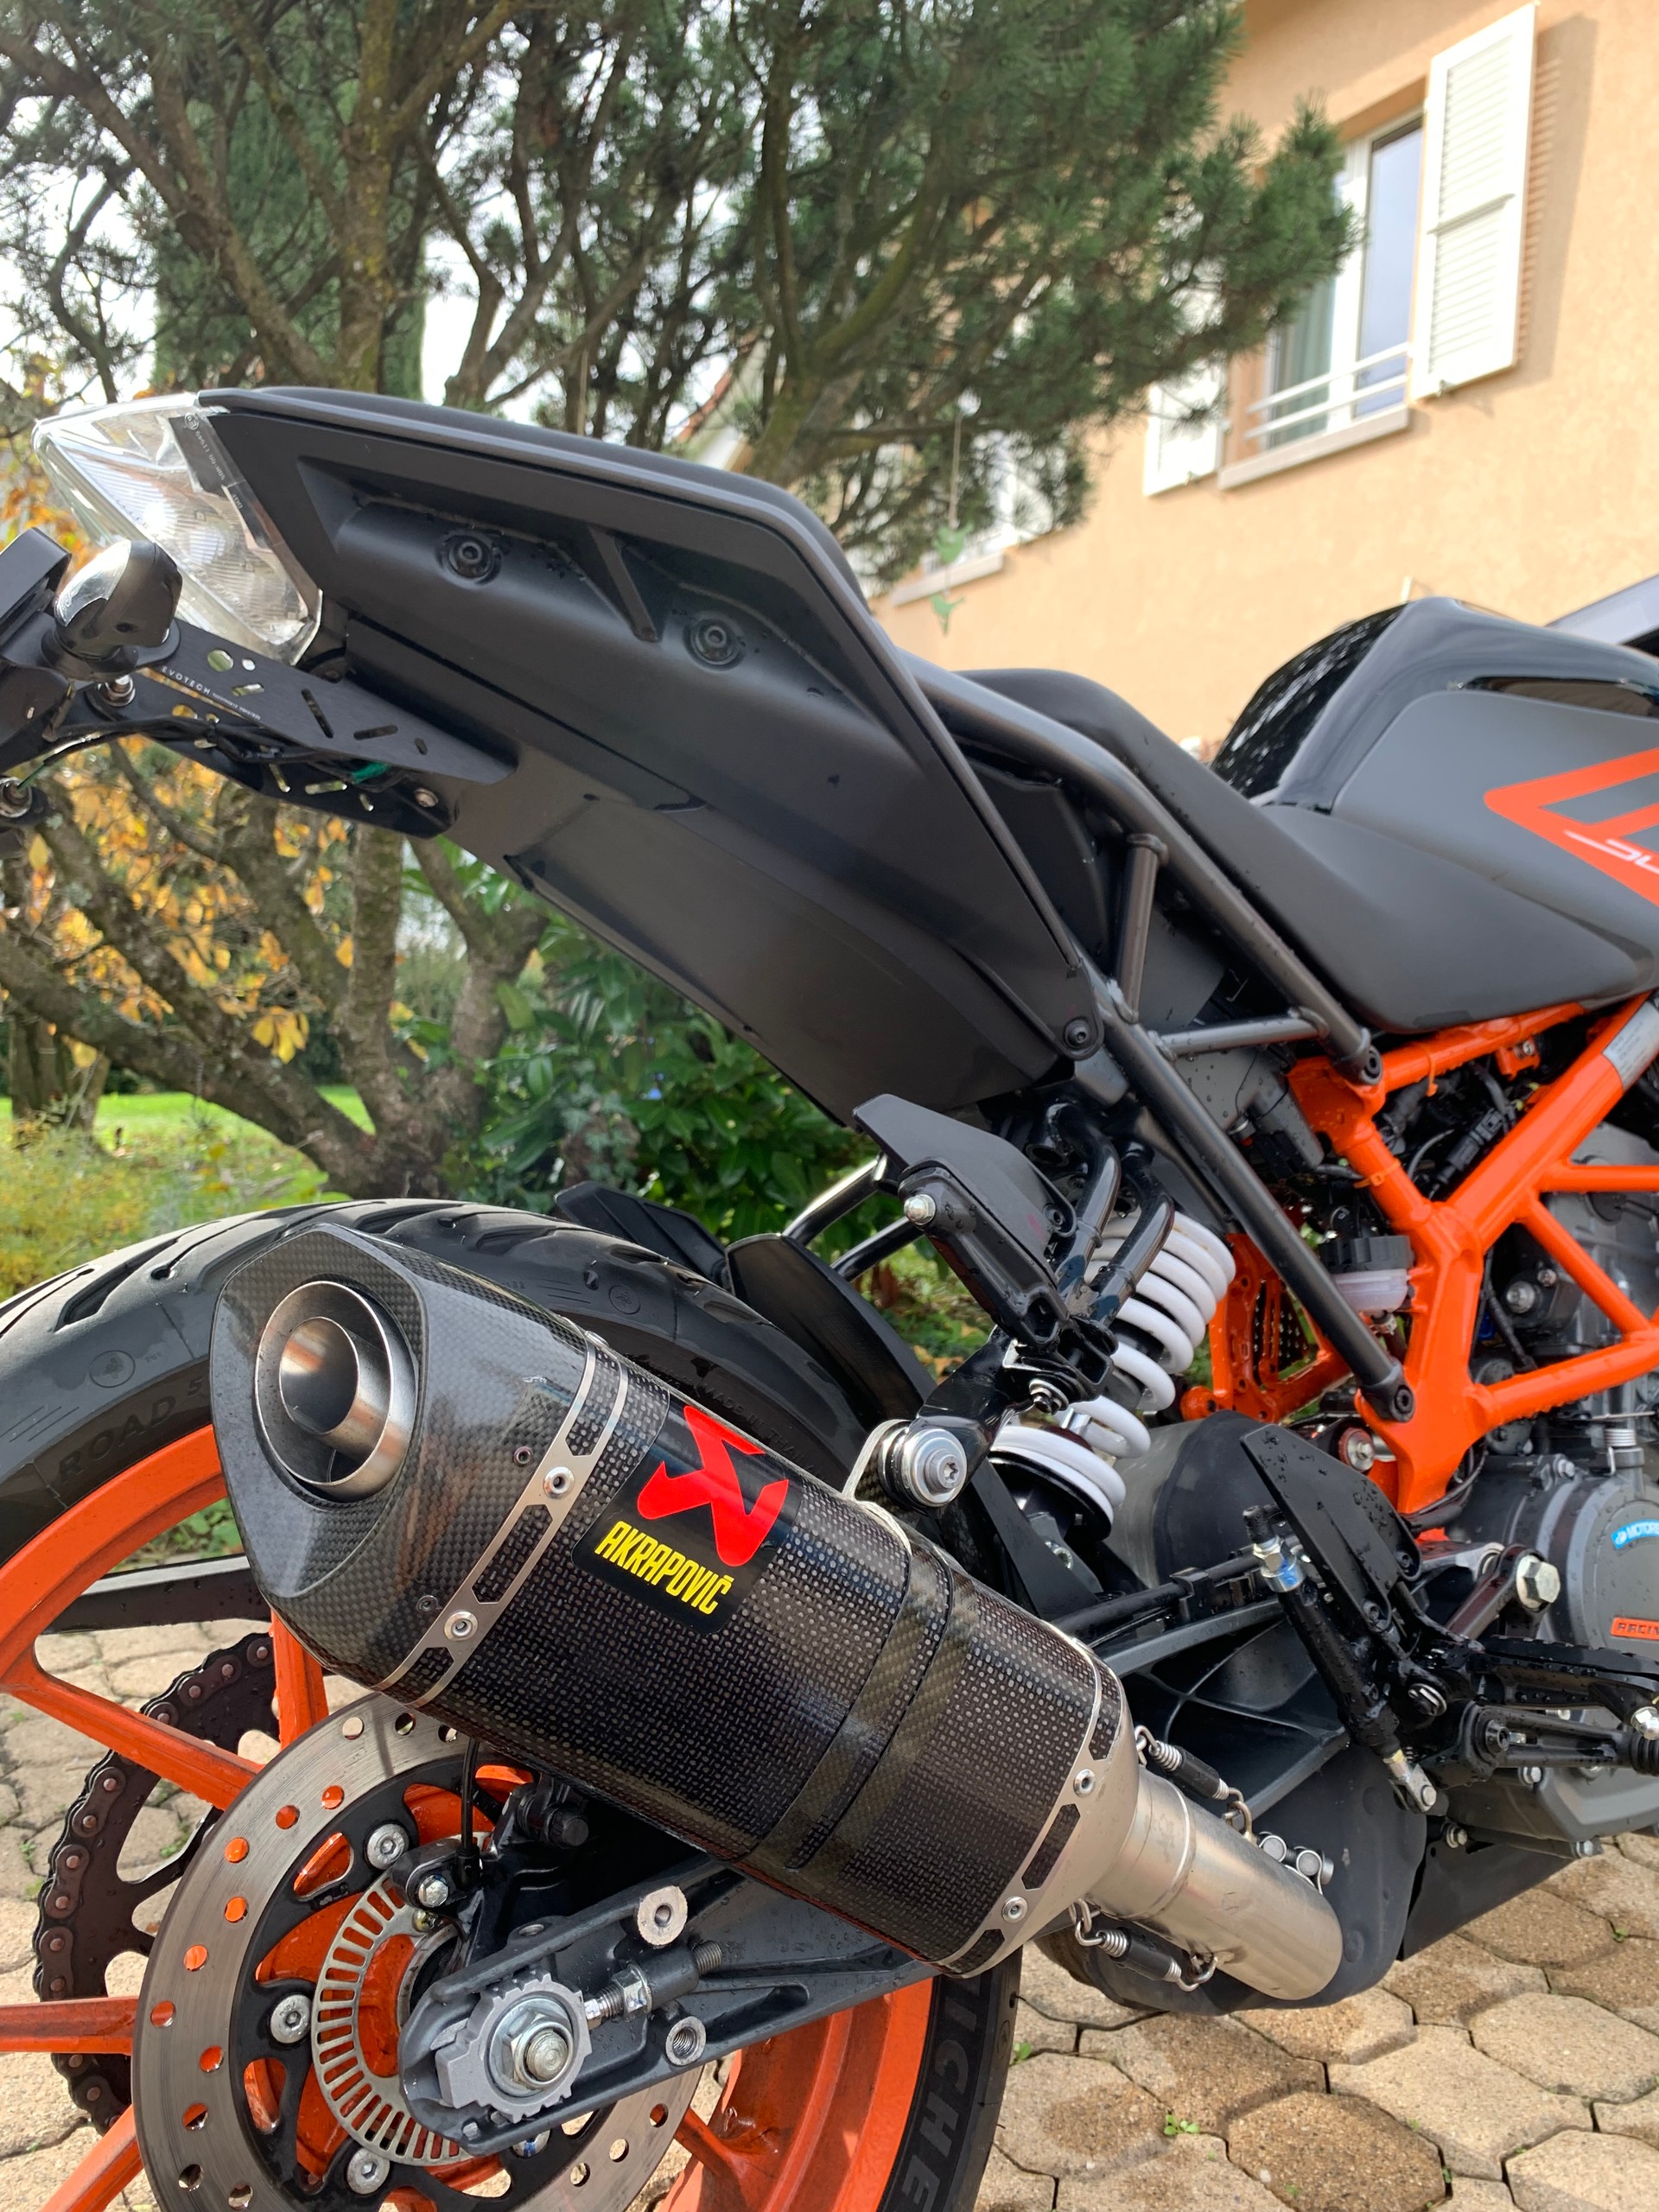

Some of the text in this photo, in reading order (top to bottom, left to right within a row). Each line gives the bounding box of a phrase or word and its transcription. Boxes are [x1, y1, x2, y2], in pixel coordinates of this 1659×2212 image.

[162, 665, 212, 695] EVOTECH
[55, 1377, 204, 1484] ROAD 5
